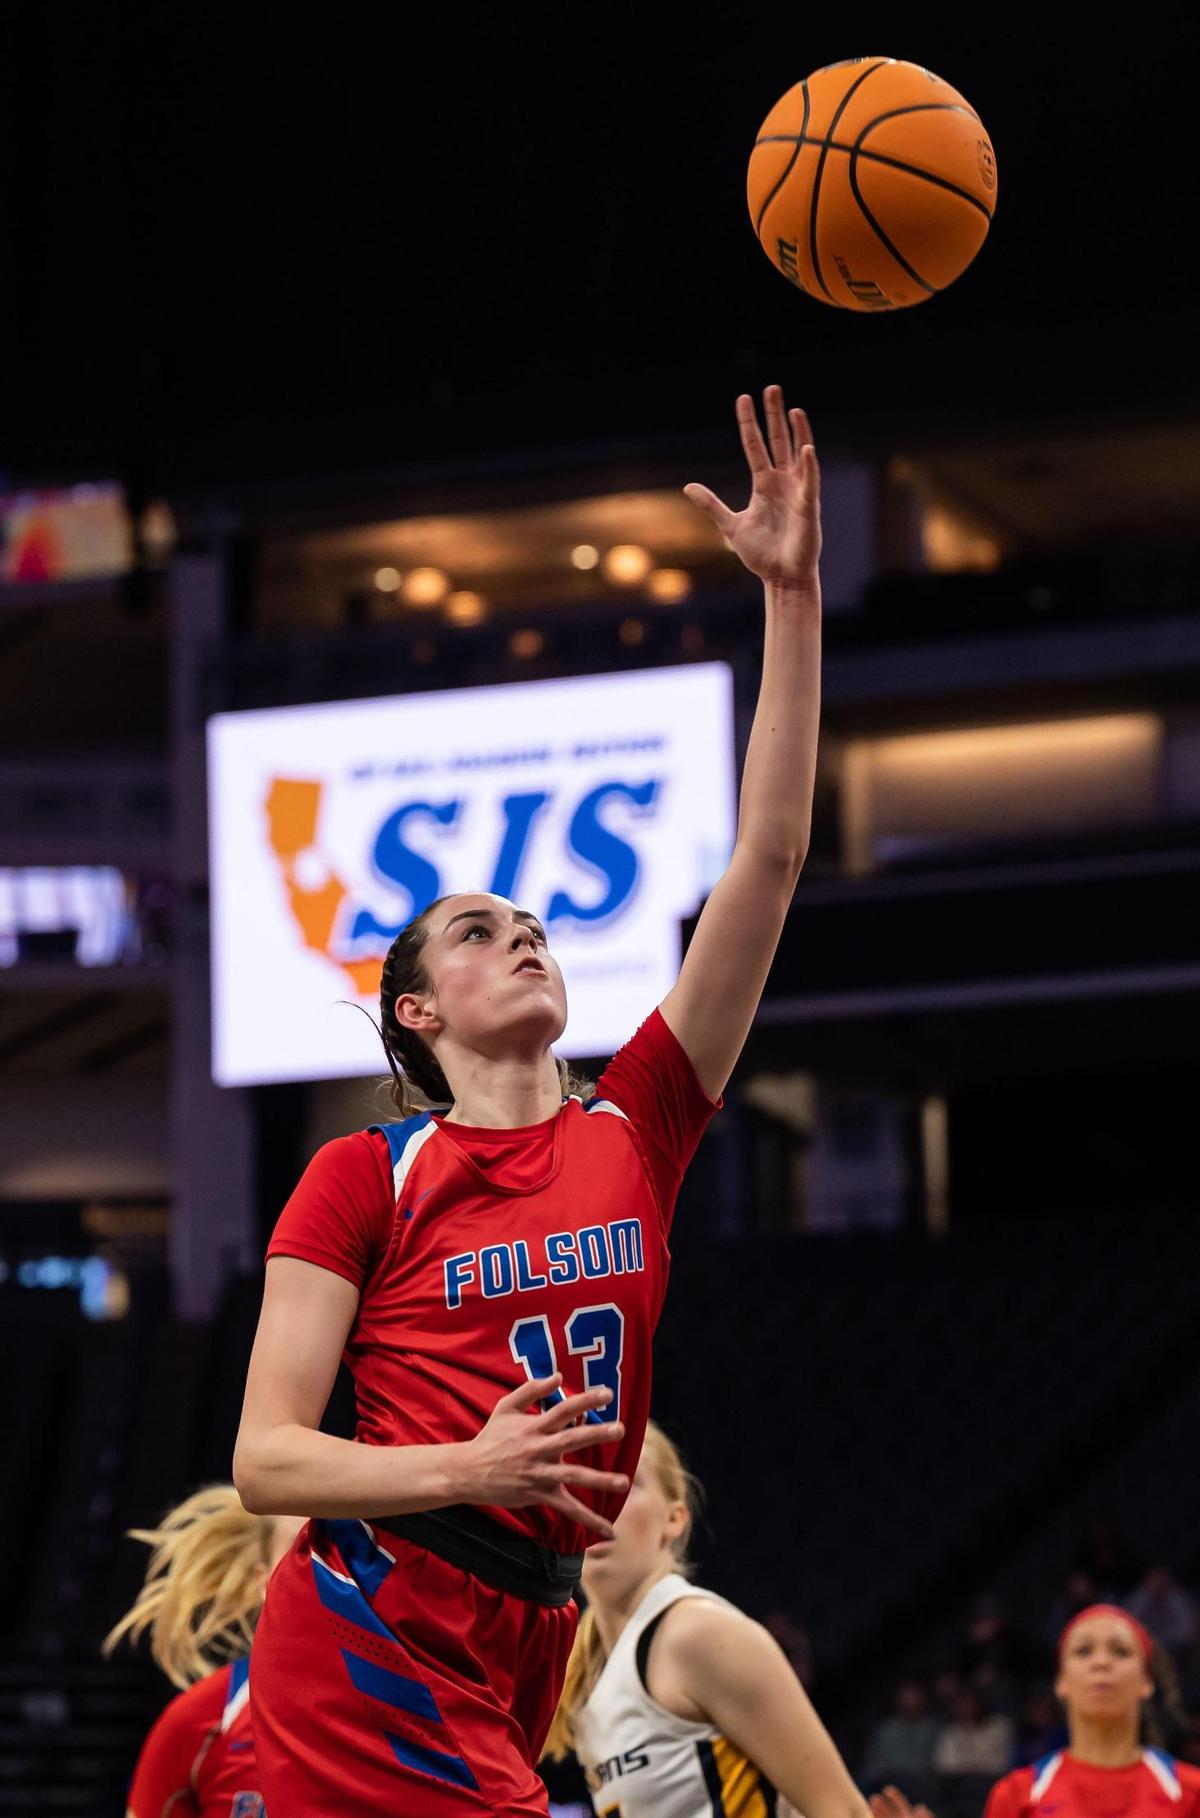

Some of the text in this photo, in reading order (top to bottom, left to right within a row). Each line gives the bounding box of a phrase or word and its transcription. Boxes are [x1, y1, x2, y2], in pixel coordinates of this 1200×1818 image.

[351, 780, 659, 939] SIS
[444, 1218, 644, 1310] FOLSOM
[508, 1303, 625, 1426] 13
